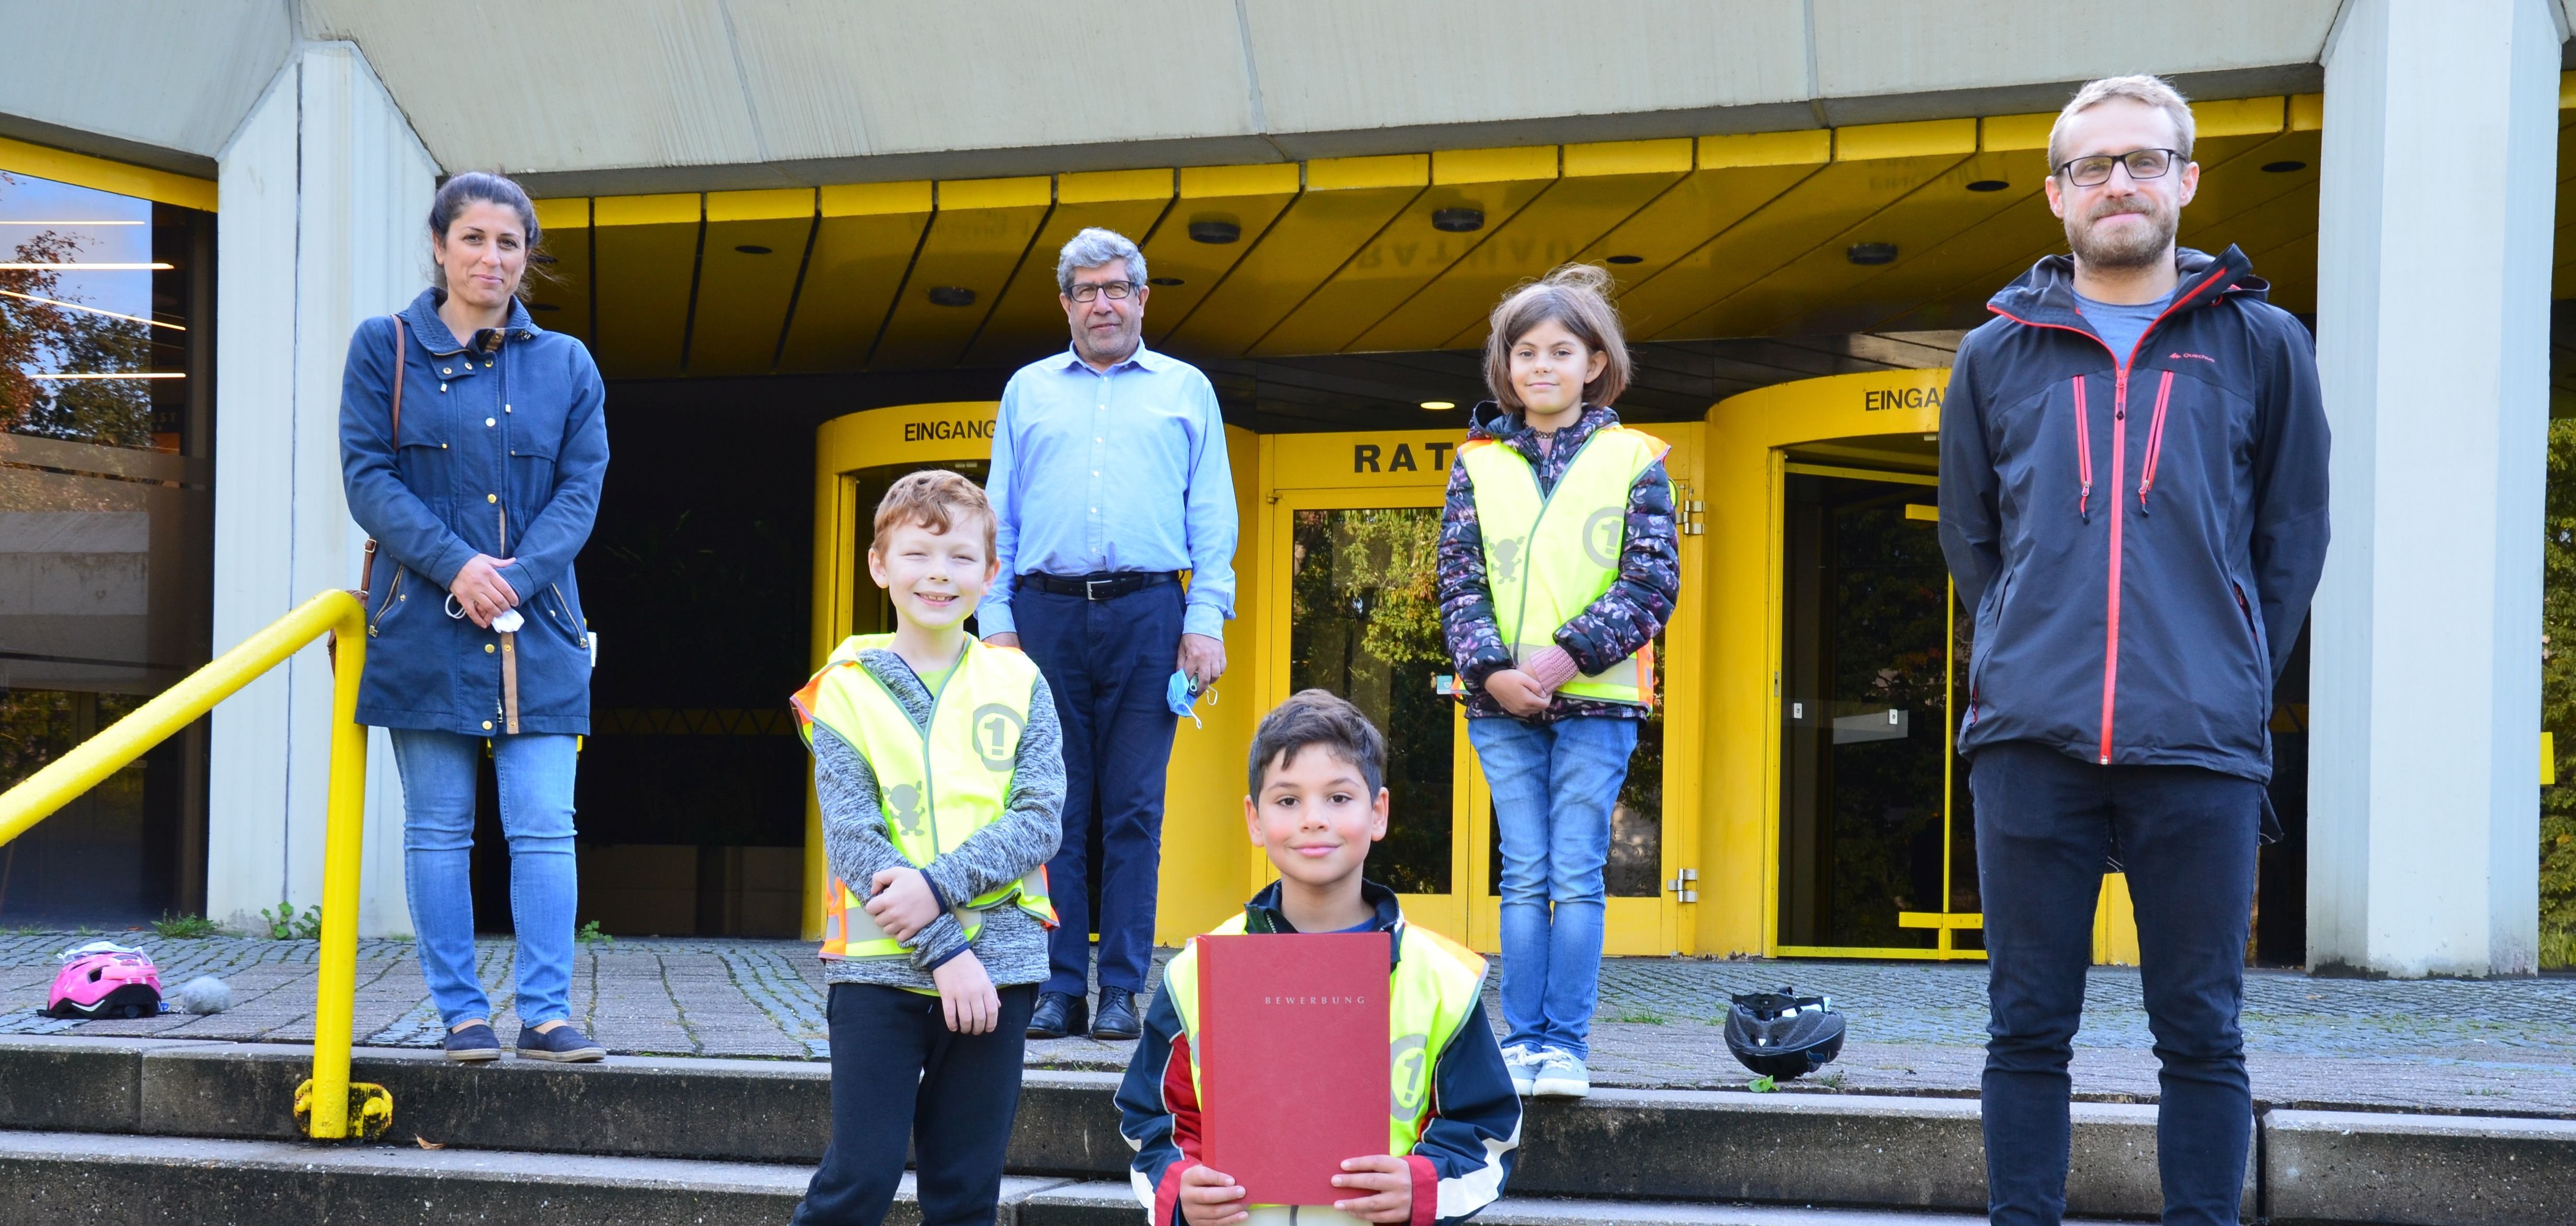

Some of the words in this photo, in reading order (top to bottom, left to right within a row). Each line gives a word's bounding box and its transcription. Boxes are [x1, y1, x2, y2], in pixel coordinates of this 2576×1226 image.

[1866, 387, 1947, 411] EINGA
[905, 420, 996, 442] EINGANG
[1354, 442, 1454, 473] RAT
[1265, 996, 1364, 1004] BEWERBUNG
